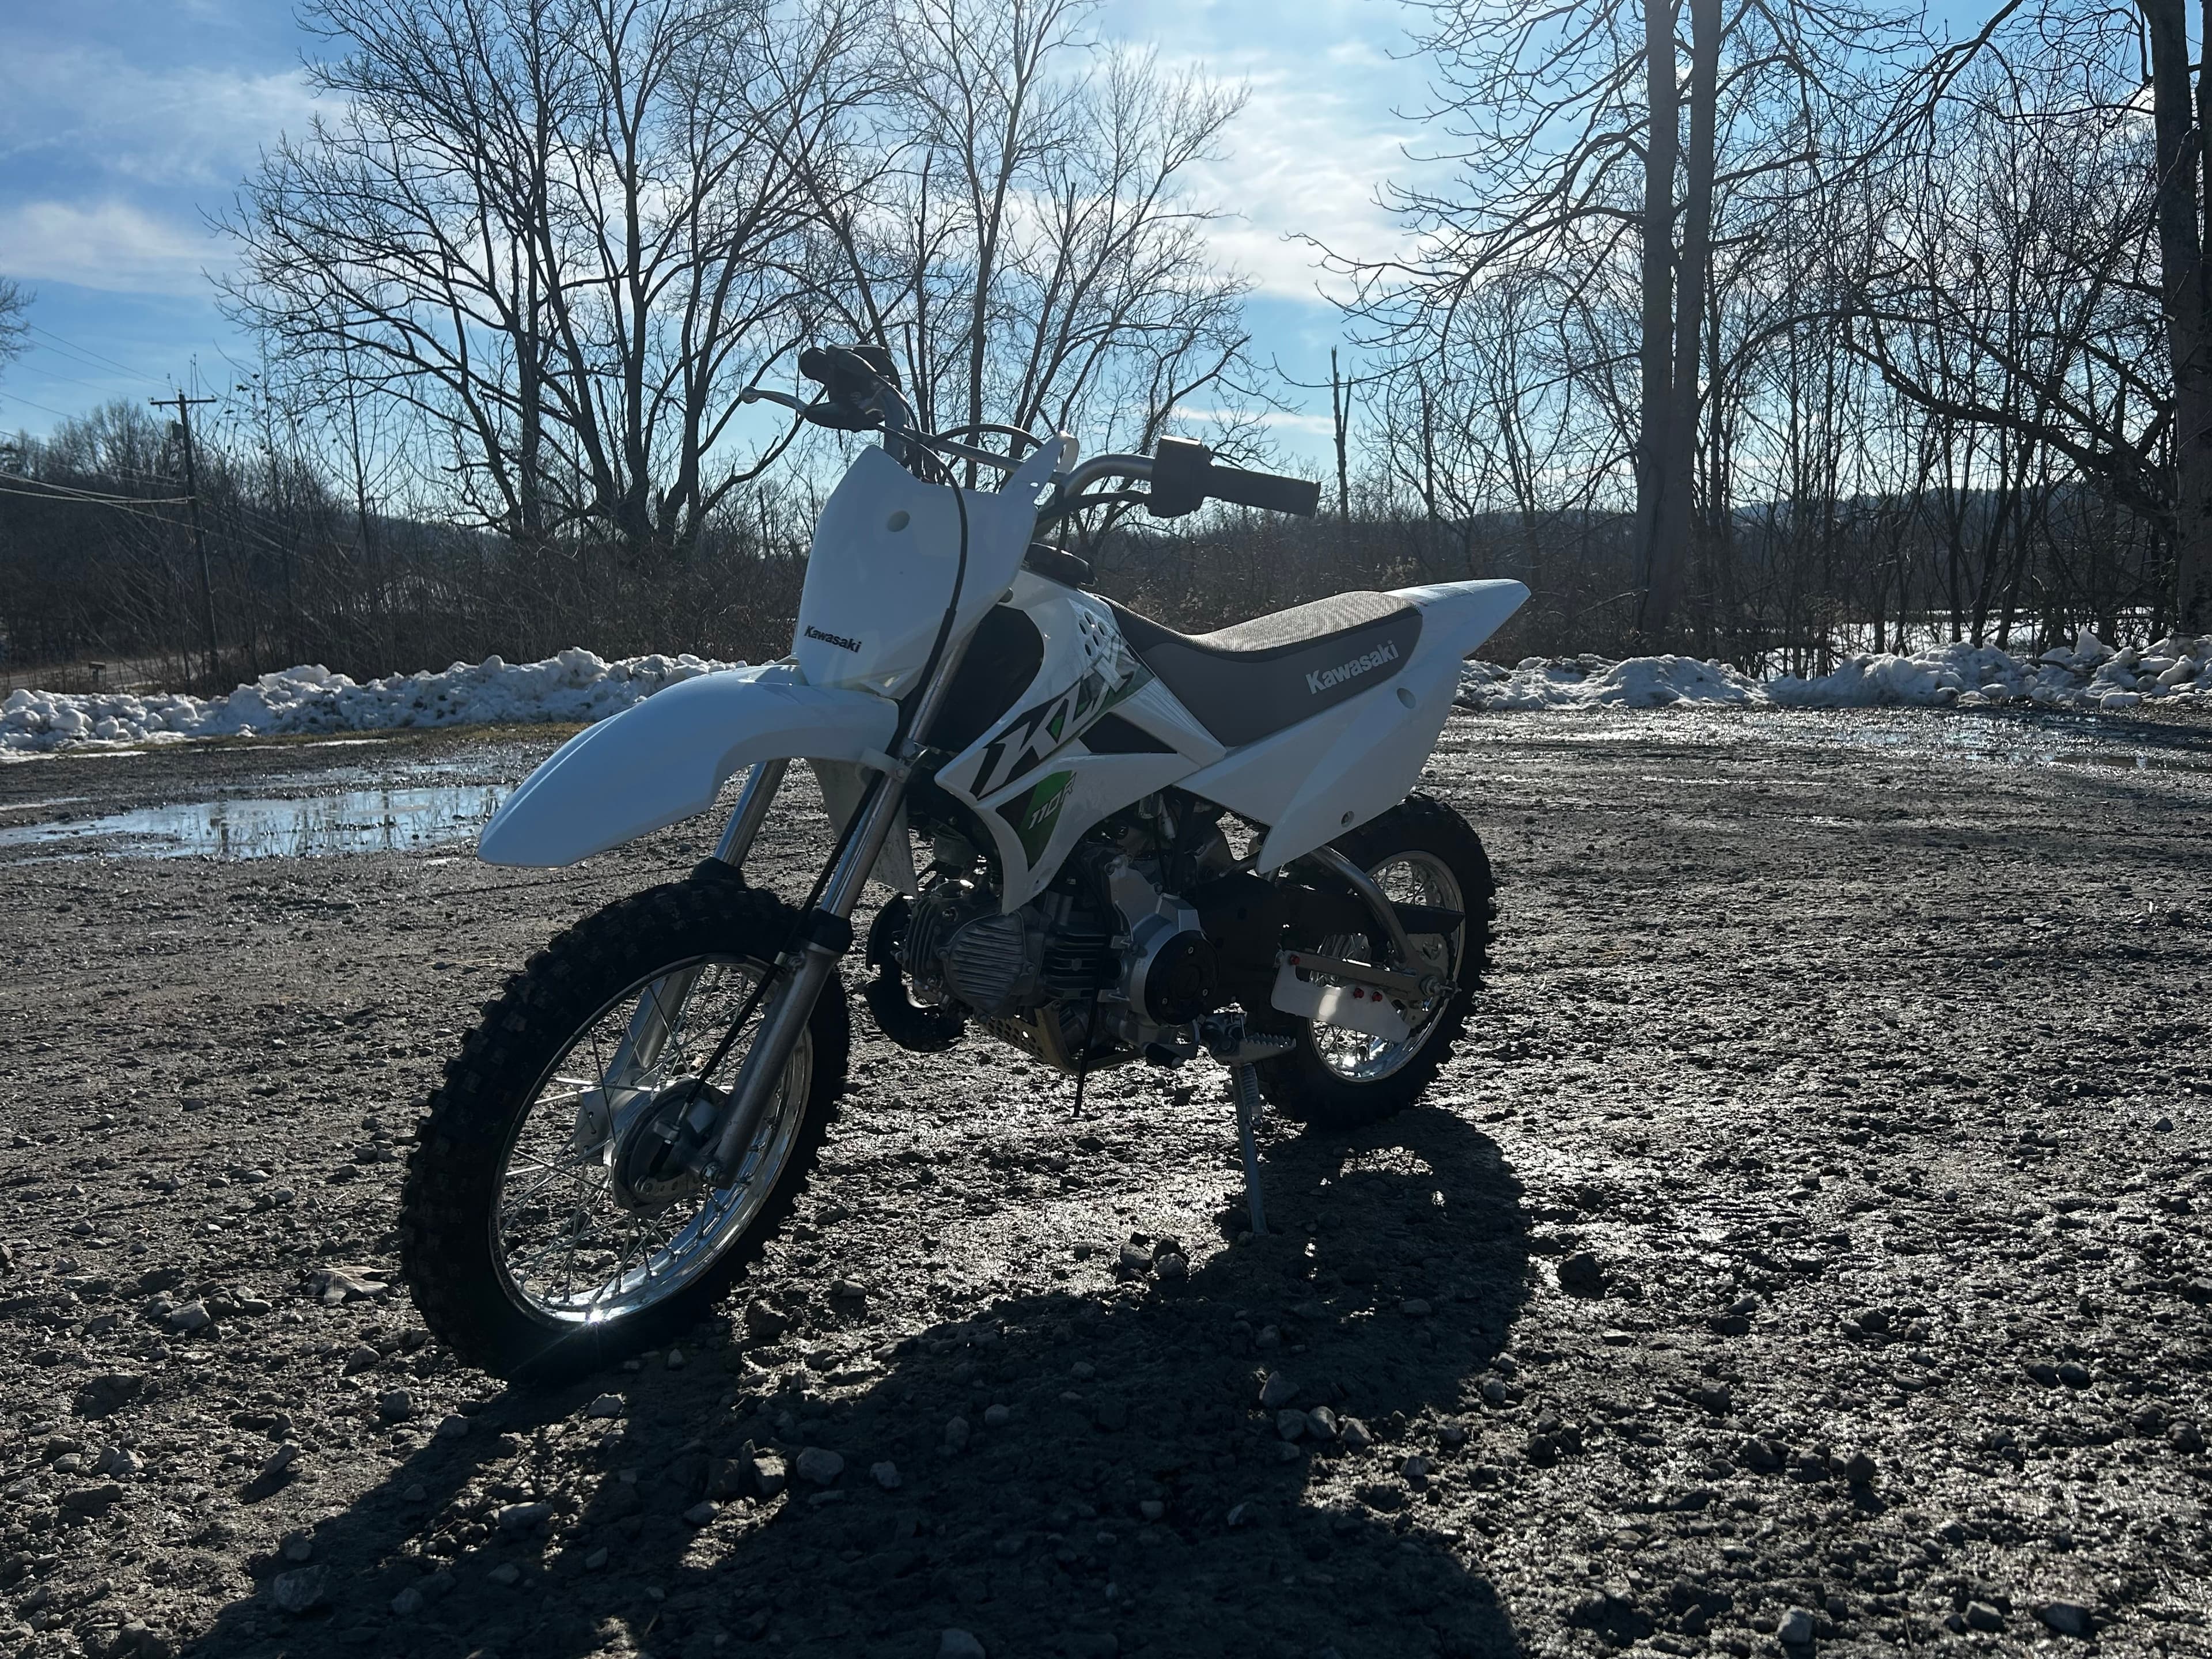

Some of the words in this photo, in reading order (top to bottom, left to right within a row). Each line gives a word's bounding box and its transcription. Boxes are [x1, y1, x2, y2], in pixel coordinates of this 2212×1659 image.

[804, 625, 862, 653] Kawasaki
[1305, 639, 1399, 695] Kawasaki
[974, 635, 1130, 801] KLX
